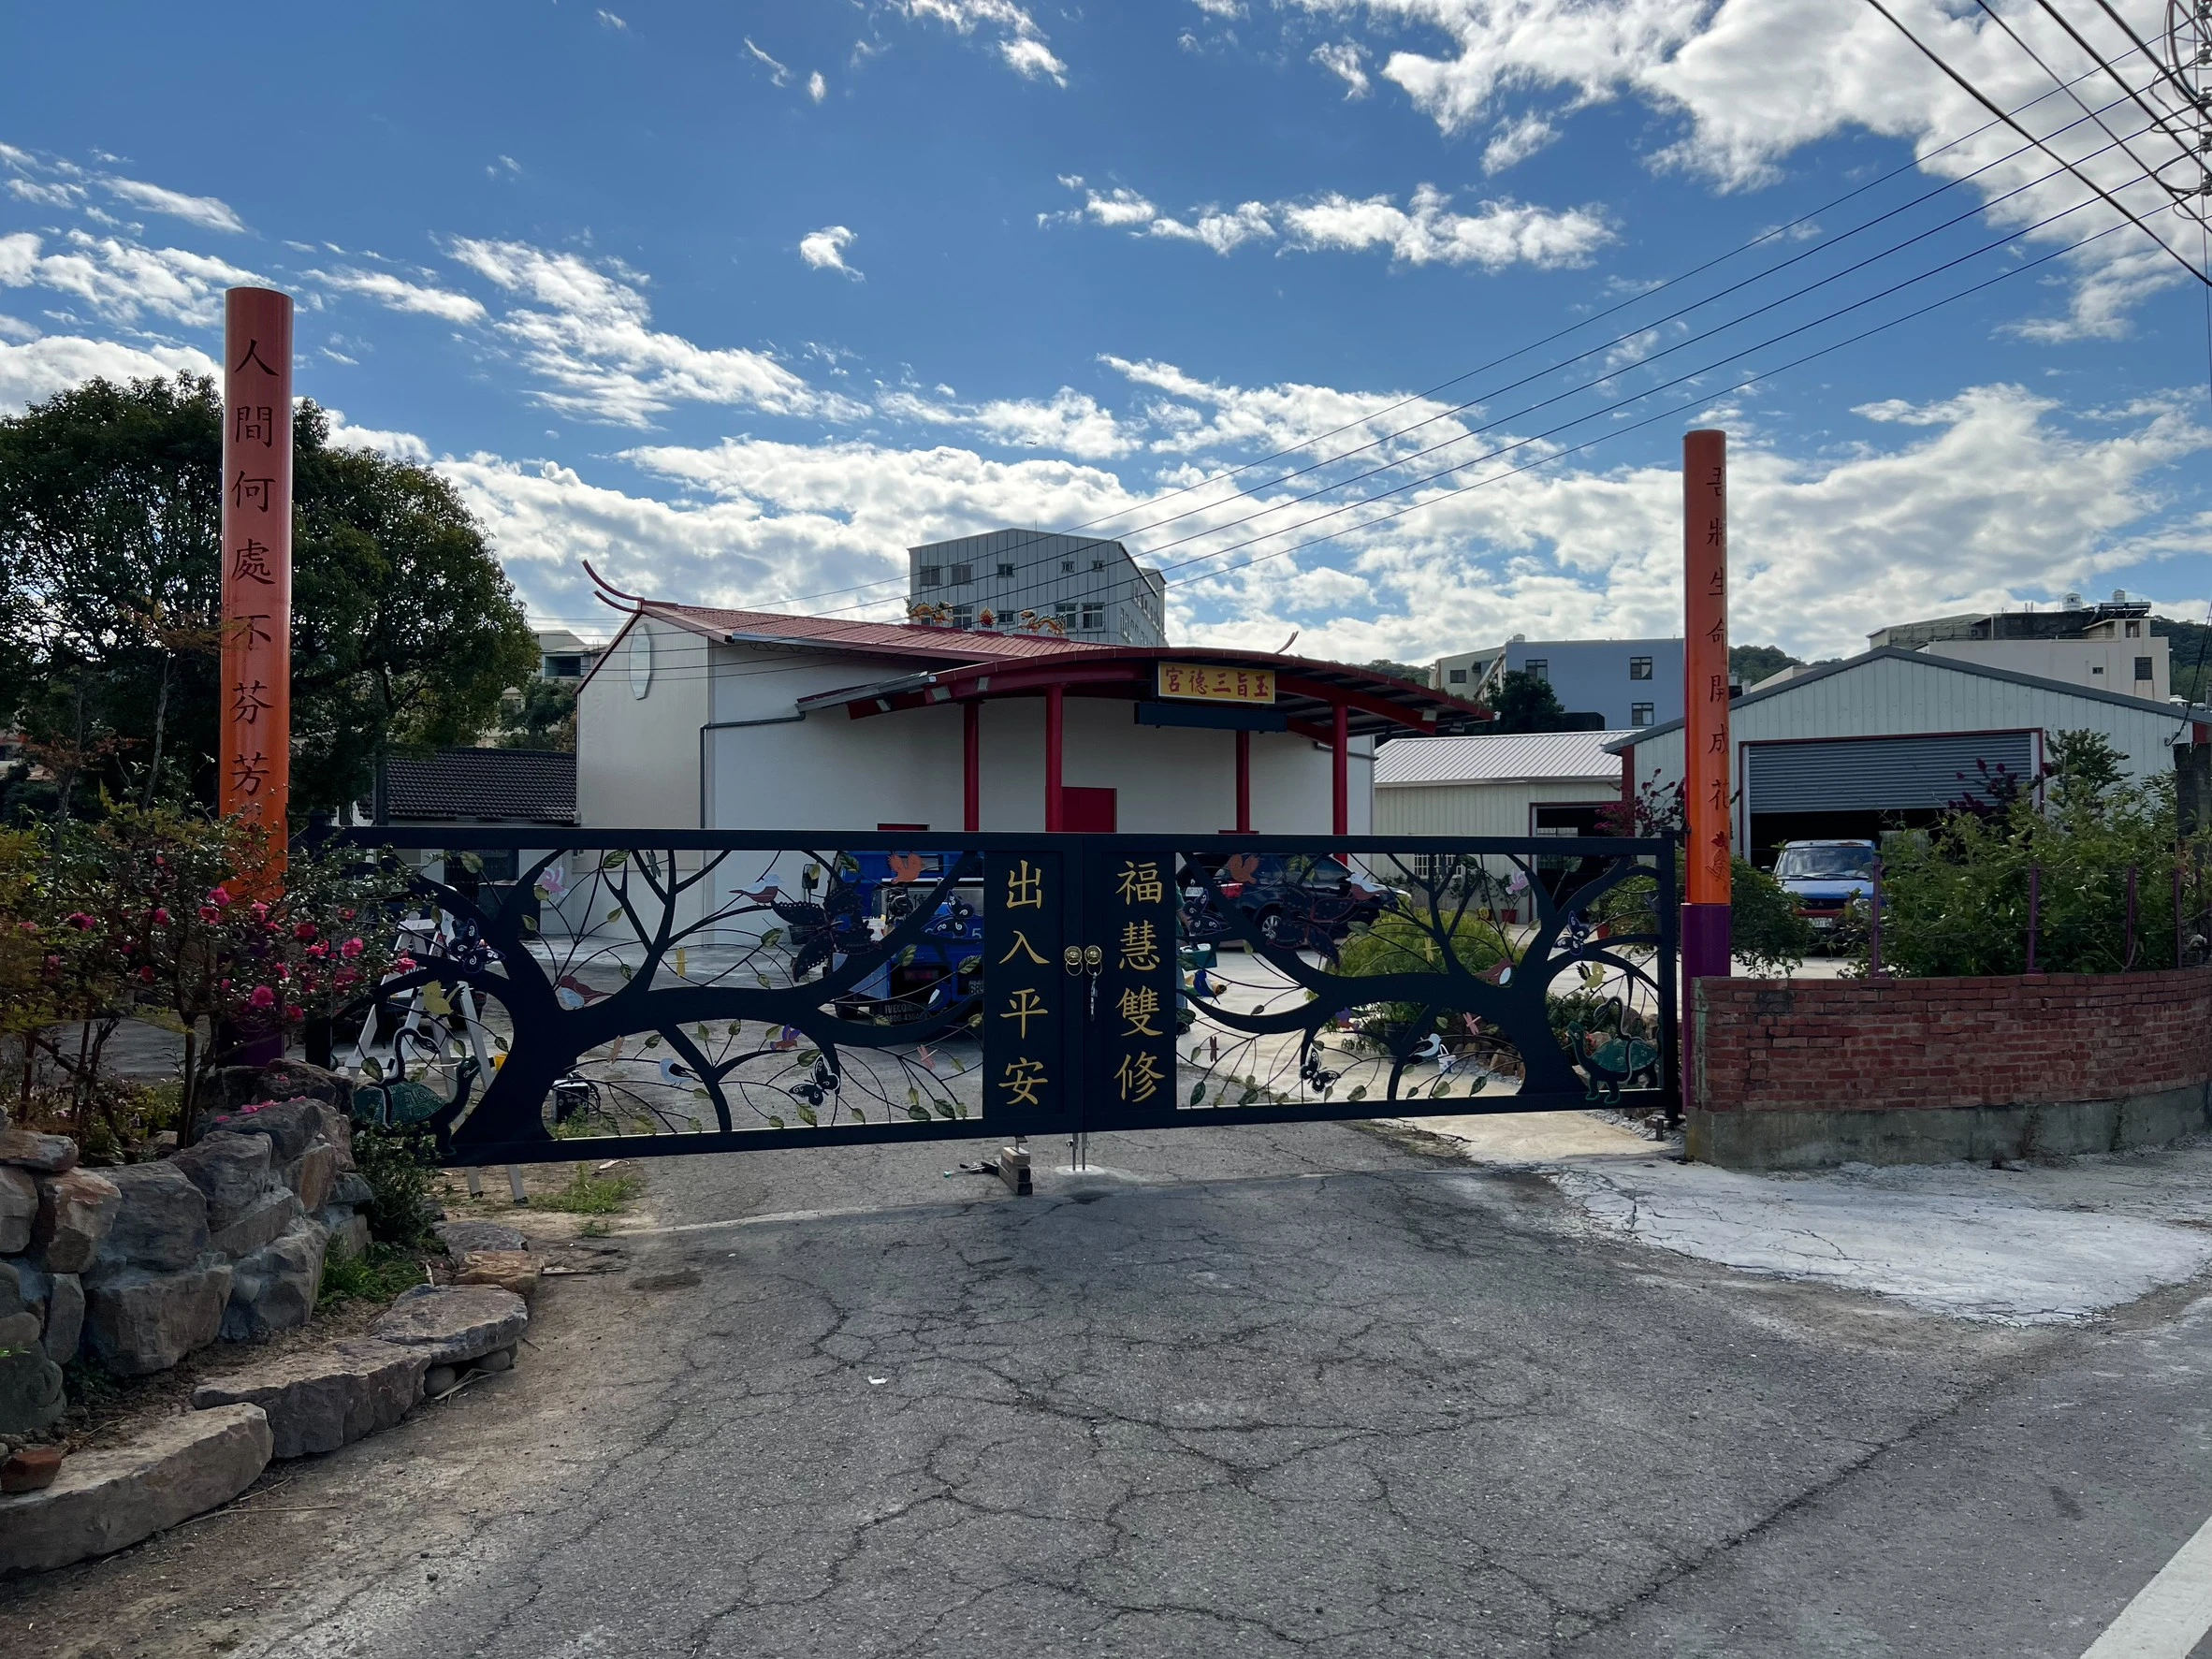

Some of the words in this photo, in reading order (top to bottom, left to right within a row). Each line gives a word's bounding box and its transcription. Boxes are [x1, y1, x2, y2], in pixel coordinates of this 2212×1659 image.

[229, 338, 279, 797] 人間何處不芬芳
[997, 859, 1051, 1106] 出入平安
[1113, 860, 1166, 1103] 福慧雙修
